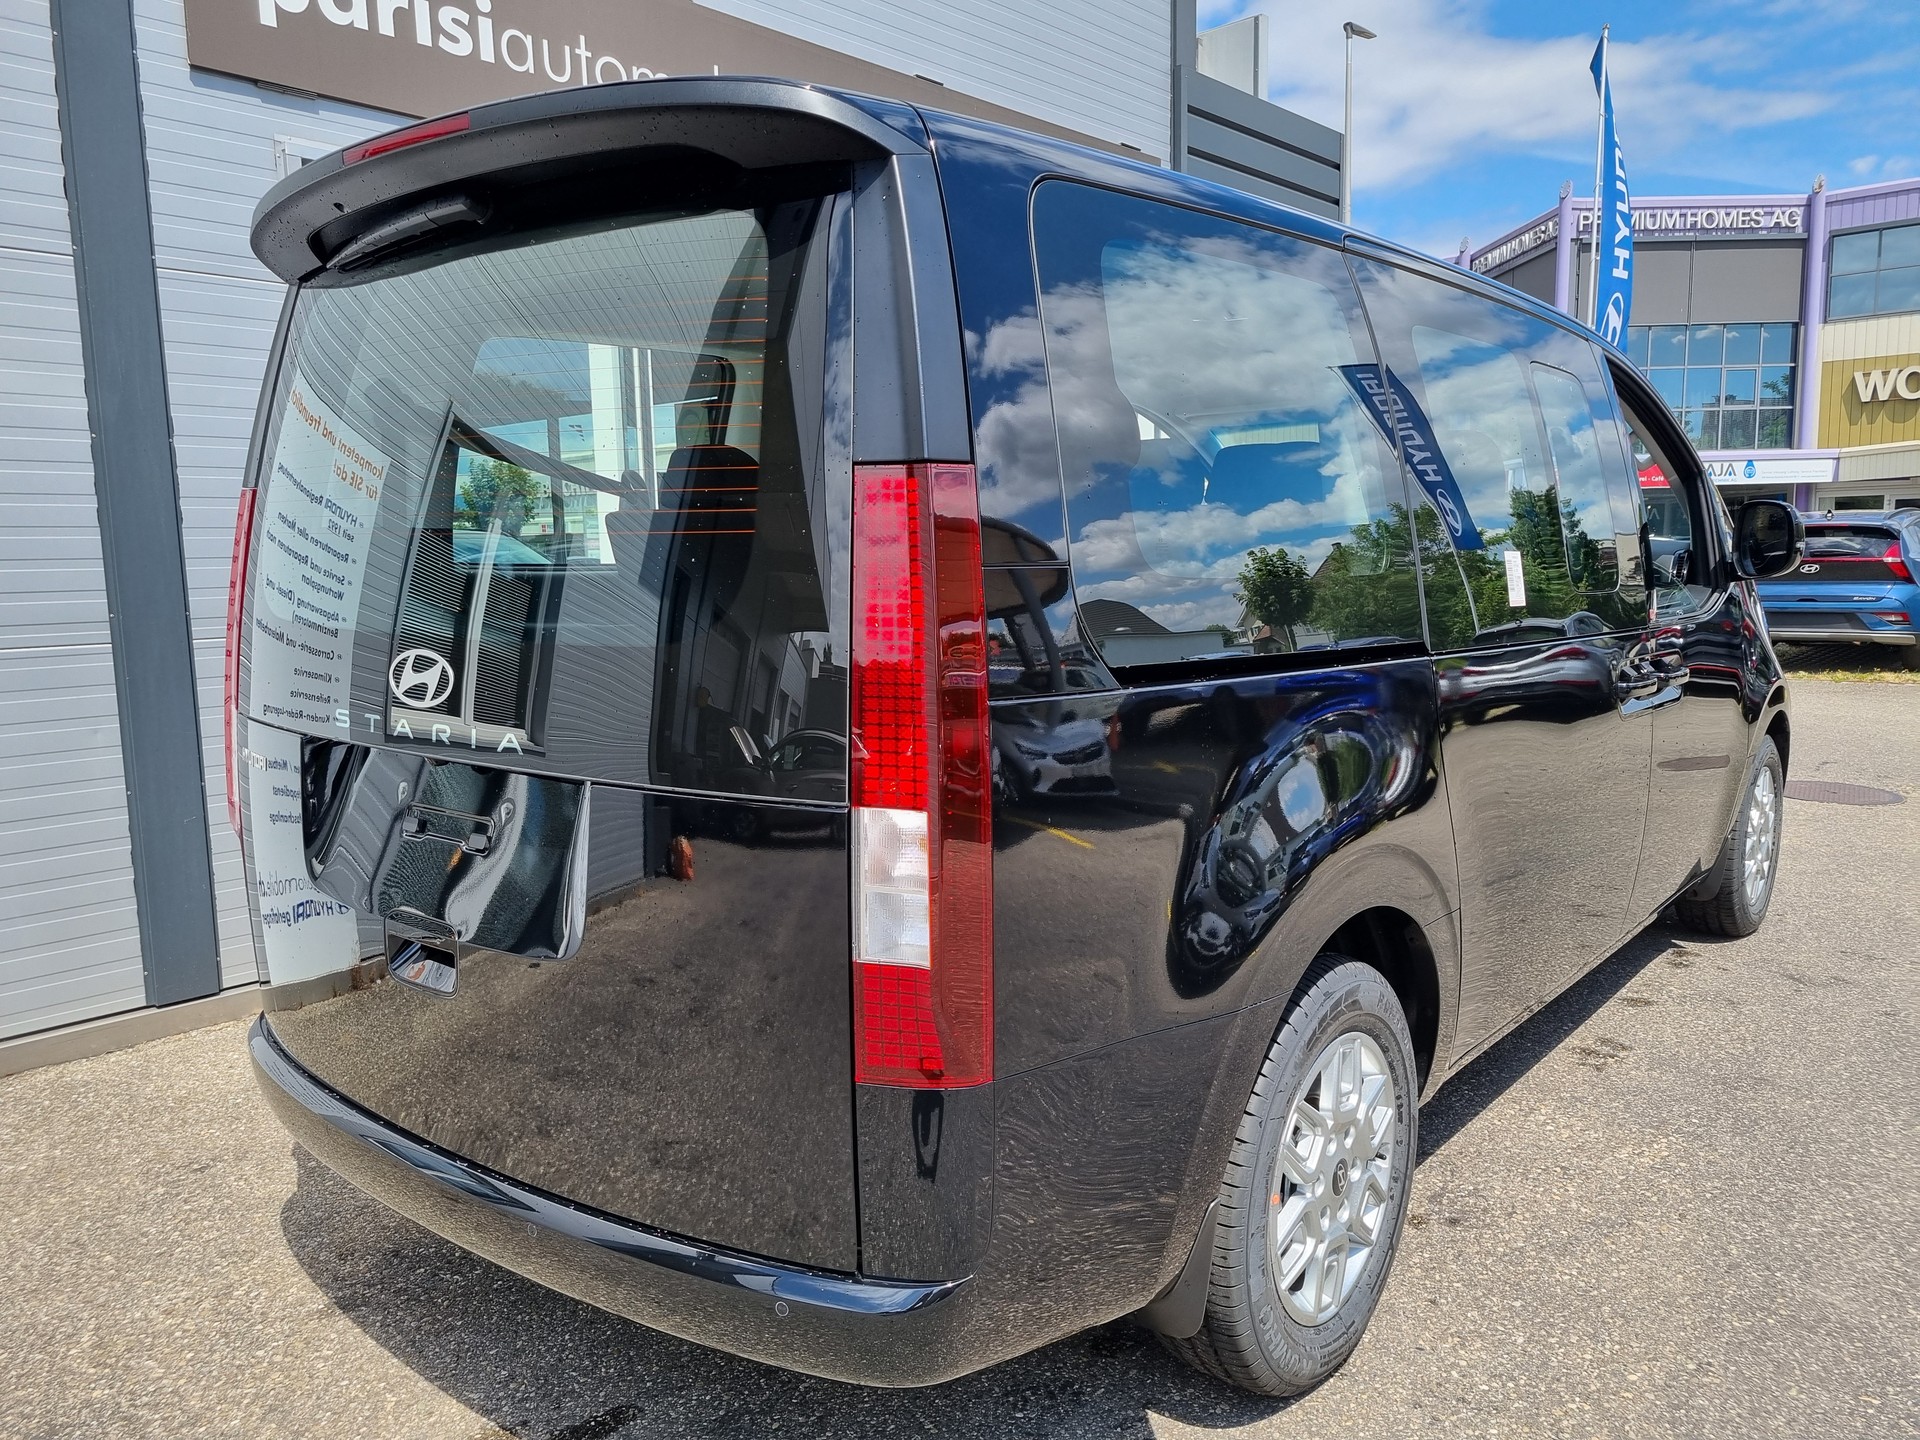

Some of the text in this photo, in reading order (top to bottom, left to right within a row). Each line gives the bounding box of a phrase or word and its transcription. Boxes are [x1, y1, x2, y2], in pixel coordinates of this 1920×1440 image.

[1685, 209, 1765, 229] HOMES
[1770, 208, 1802, 228] AG
[1510, 223, 1547, 258] HOMES
[335, 709, 524, 756] STARIA
